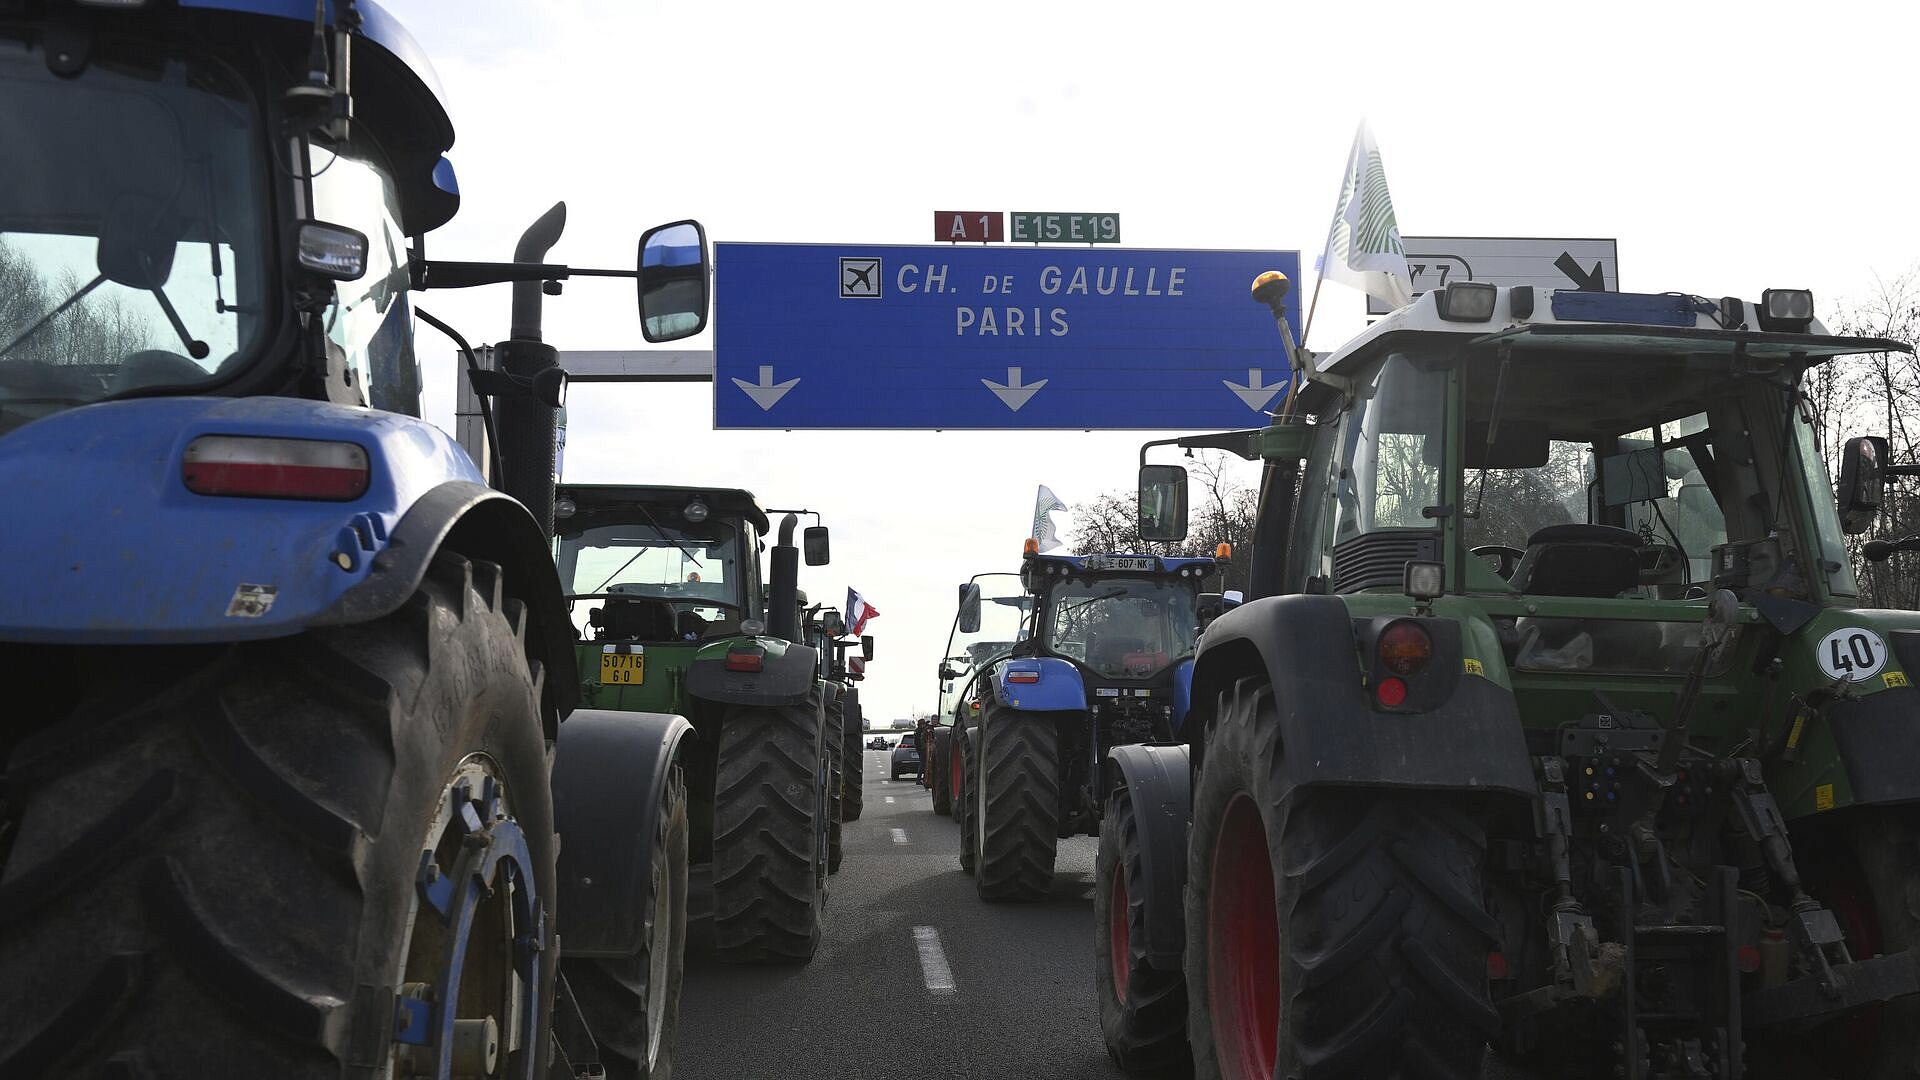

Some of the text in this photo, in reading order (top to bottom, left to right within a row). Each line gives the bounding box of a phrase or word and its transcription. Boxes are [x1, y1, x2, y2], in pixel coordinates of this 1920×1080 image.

[951, 215, 989, 239] A 1
[1014, 215, 1116, 240] E15 E19
[897, 264, 1186, 297] CH. DE GAULLE
[1436, 265, 1450, 287] 7
[956, 307, 1069, 337] PARIS
[603, 655, 642, 669] 50716
[1830, 633, 1875, 672] 40
